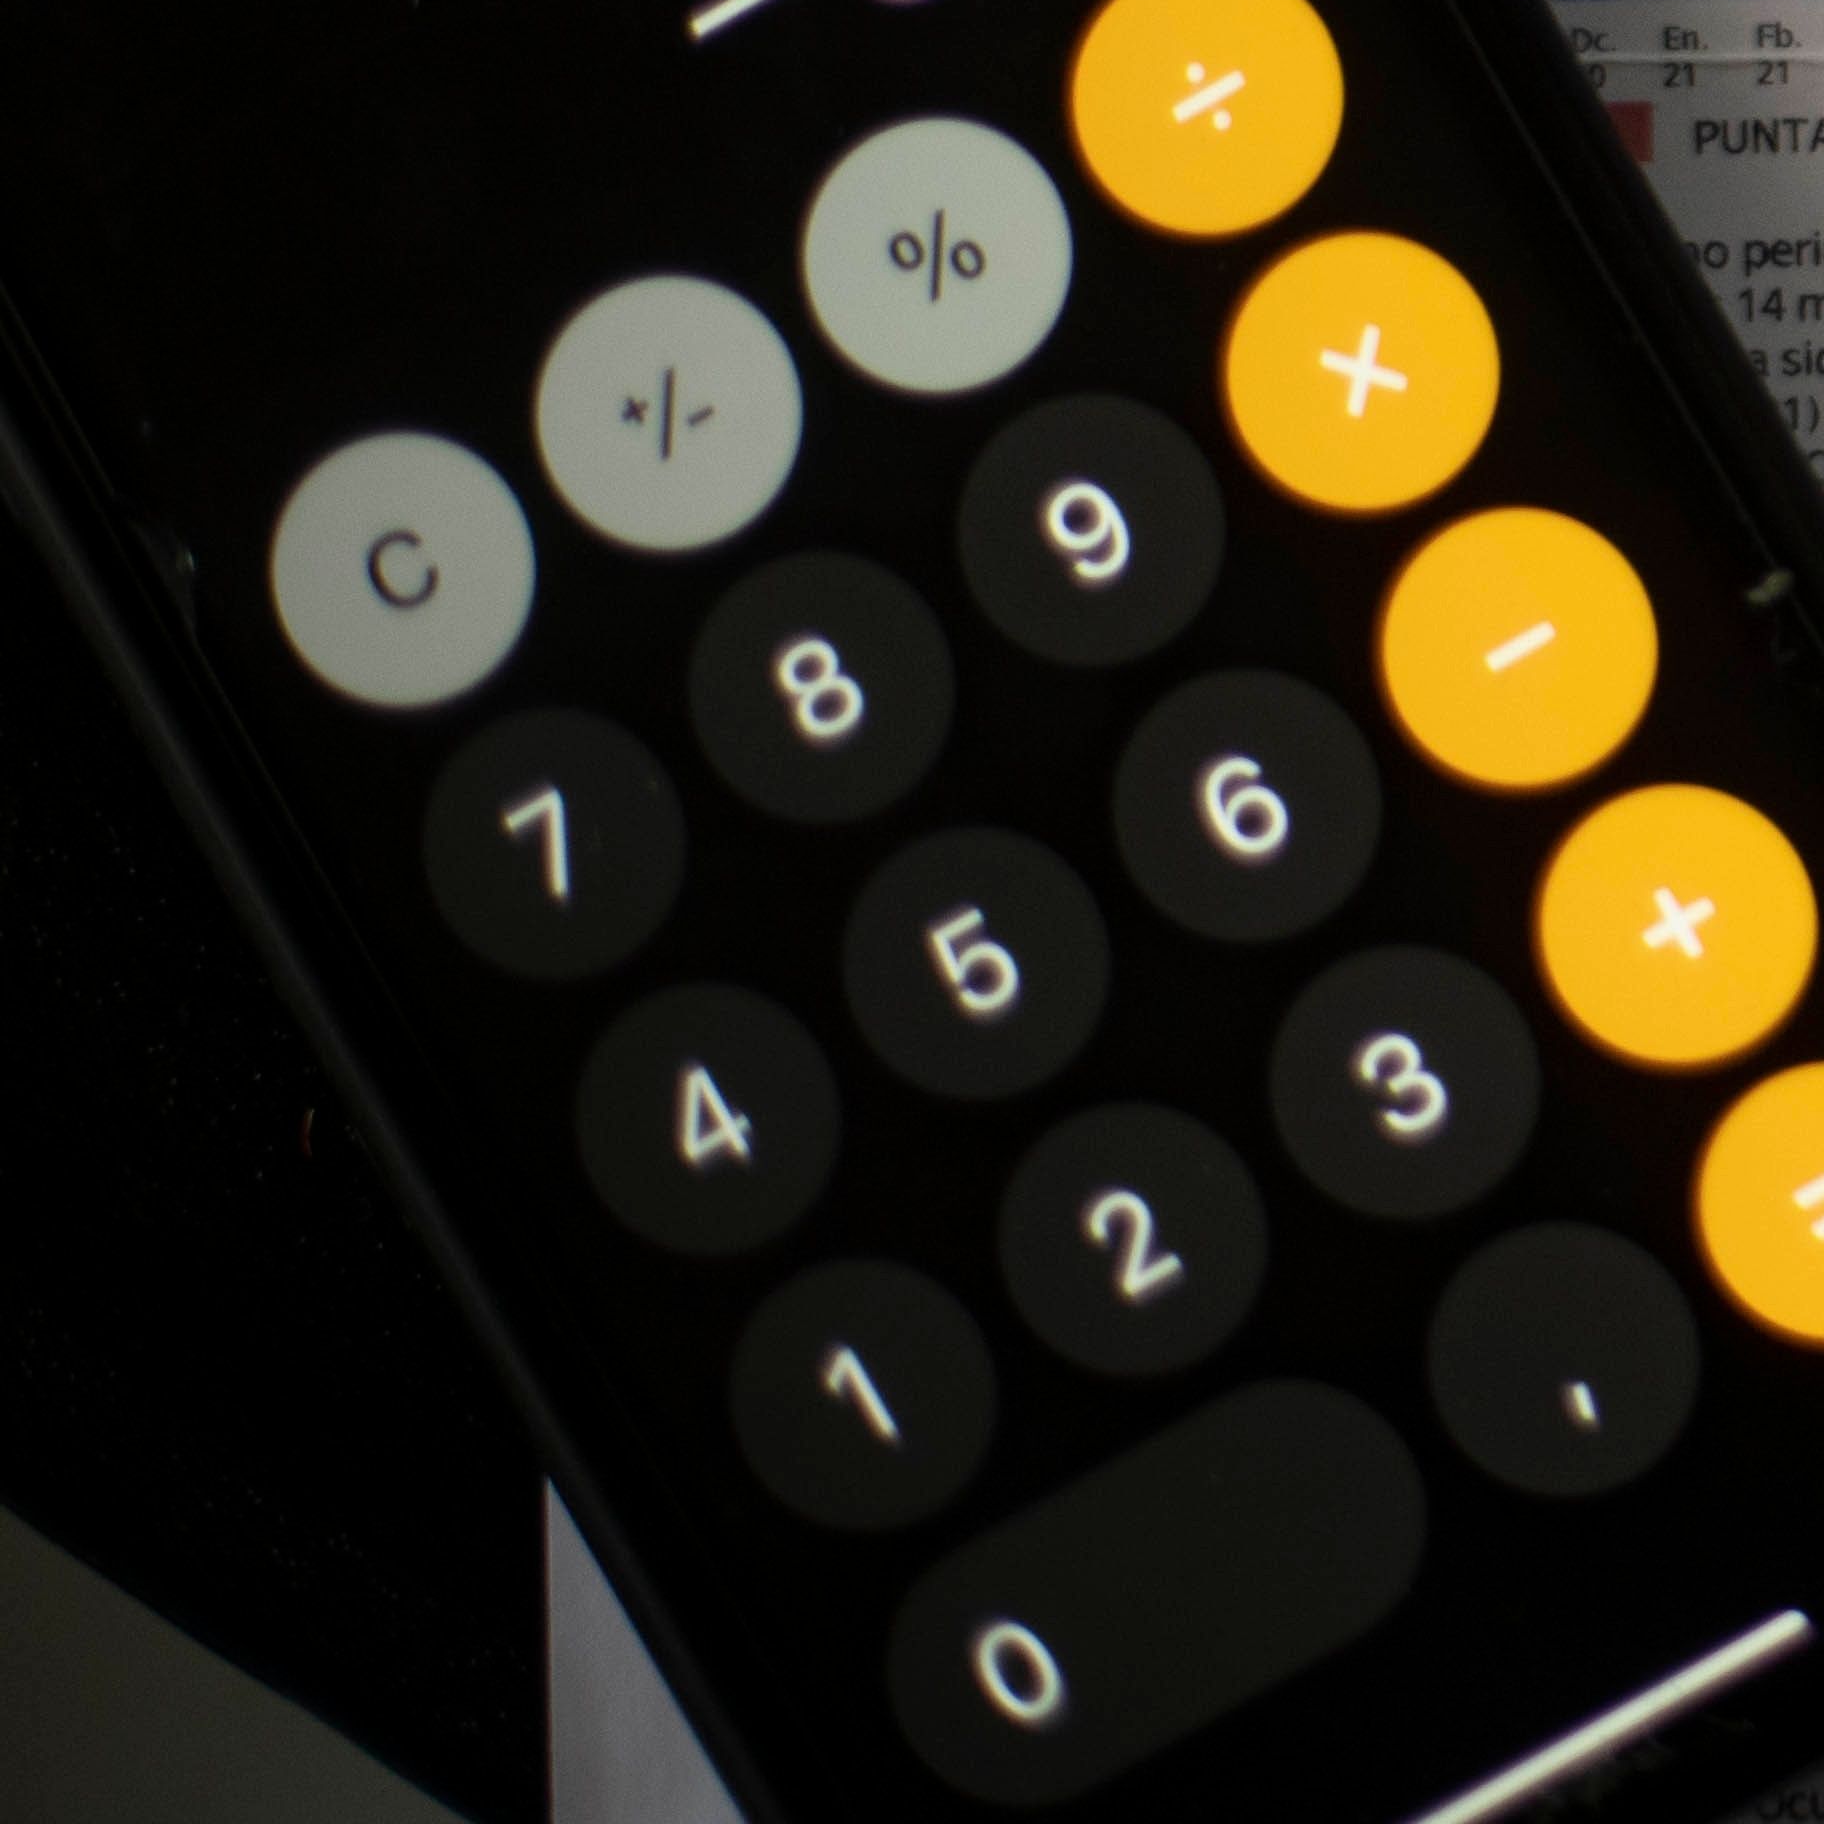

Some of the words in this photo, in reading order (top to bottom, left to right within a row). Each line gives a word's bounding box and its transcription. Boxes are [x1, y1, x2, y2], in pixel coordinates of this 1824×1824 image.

[365, 529, 439, 611] C
[889, 212, 984, 301] %
[1739, 287, 1784, 322] 14
[506, 791, 567, 895] 7
[777, 639, 863, 738] 8
[1045, 482, 1130, 581] 9
[681, 1066, 751, 1164] 4
[931, 909, 1018, 1012] 5
[1202, 756, 1288, 856] 6
[826, 1348, 897, 1439] 1
[1088, 1191, 1180, 1297] 2
[1358, 1034, 1447, 1134] 3
[978, 1624, 1060, 1719] 0
